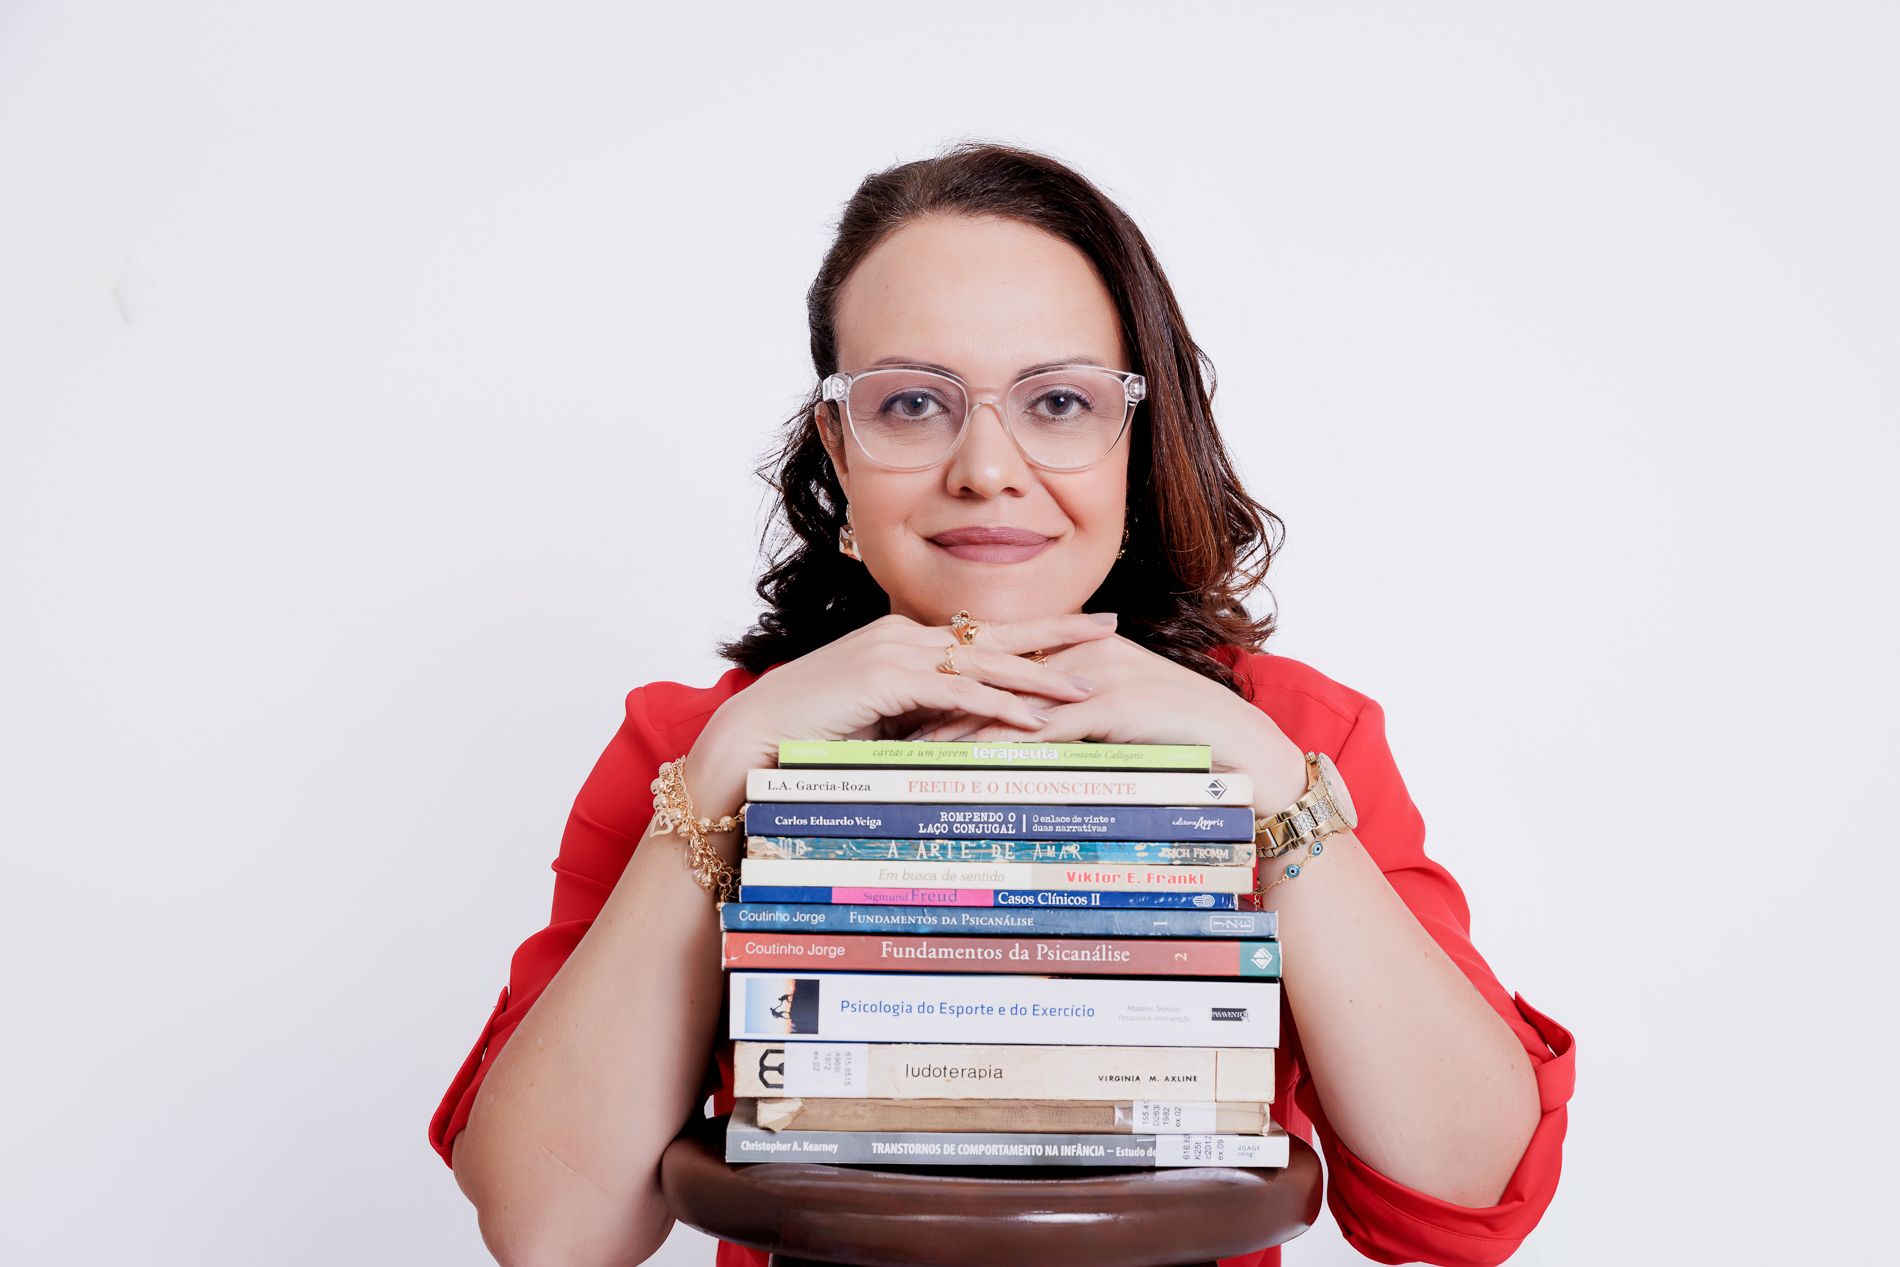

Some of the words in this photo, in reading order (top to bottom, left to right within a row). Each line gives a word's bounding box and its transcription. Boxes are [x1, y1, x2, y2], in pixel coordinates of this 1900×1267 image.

[873, 748, 903, 757] cartas
[917, 750, 934, 758] um
[937, 749, 968, 760] jovem
[972, 745, 1058, 763] terapeuta
[1063, 749, 1101, 760] Contardo
[1104, 750, 1144, 761] Calligaris
[768, 781, 791, 791] L.A.
[796, 781, 871, 791] Garcia-Roza
[909, 781, 965, 793] FREUD
[971, 782, 982, 793] E
[987, 782, 999, 794] O
[1005, 782, 1136, 795] INCONSCIENTE
[775, 816, 808, 826] Carlos
[810, 816, 854, 826] Eduardo
[855, 817, 882, 829] Veiga
[940, 812, 1004, 822] ROMPENDO
[1009, 813, 1016, 822] O
[1032, 815, 1039, 823] O
[1041, 815, 1070, 824] enlace
[1084, 815, 1108, 824] vinte
[919, 823, 948, 835] LAÇO
[953, 824, 1016, 834] CONJUGAL
[1032, 823, 1053, 832] duas
[1055, 824, 1107, 832] narrativas
[888, 840, 899, 858] A
[917, 840, 972, 859] ARTE
[991, 842, 1015, 859] DE
[1033, 842, 1082, 860] AMAR
[1194, 848, 1228, 859] FROMM
[879, 869, 898, 880] Em
[903, 869, 937, 881] busca
[941, 870, 957, 881] de
[961, 870, 1005, 882] sentido
[1066, 871, 1121, 883] Viktor
[1128, 872, 1140, 883] E.
[1147, 873, 1204, 884] Frankl
[863, 892, 908, 903] Sigmund
[912, 889, 957, 902] Freud
[998, 892, 1034, 905] Casos
[1037, 892, 1087, 905] Clínicos
[1090, 893, 1100, 905] II
[739, 910, 789, 922] Coutinho
[793, 911, 825, 923] Jorge
[850, 912, 937, 925] FUNDAMENTOS
[942, 916, 957, 925] DA
[962, 913, 1033, 927] PSICANÁLISE
[745, 942, 803, 955] Coutinho
[807, 943, 845, 958] Jorge
[881, 941, 1002, 960] Fundamentos
[1009, 943, 1029, 961] da
[1037, 944, 1130, 962] Psicanálise
[1175, 952, 1187, 961] 2
[841, 1000, 912, 1016] Psicologia
[917, 1001, 934, 1014] do
[939, 1002, 994, 1018] Esporte
[998, 1006, 1006, 1015] e
[1010, 1003, 1027, 1016] do
[1032, 1004, 1095, 1017] Exercício
[905, 1063, 1003, 1080] ludoterapia
[1174, 1107, 1182, 1128] ex.02
[741, 1140, 791, 1153] Christopher
[792, 1142, 801, 1151] A.
[803, 1142, 838, 1154] Kearney
[872, 1143, 941, 1155] TRANSTORNOS
[943, 1143, 955, 1155] DE
[958, 1143, 1042, 1157] COMPORTAMENTO
[1045, 1144, 1059, 1156] NA
[1061, 1143, 1104, 1157] INFÂNCIA
[1116, 1147, 1145, 1157] Estudo
[1216, 1139, 1224, 1160] ex.09
